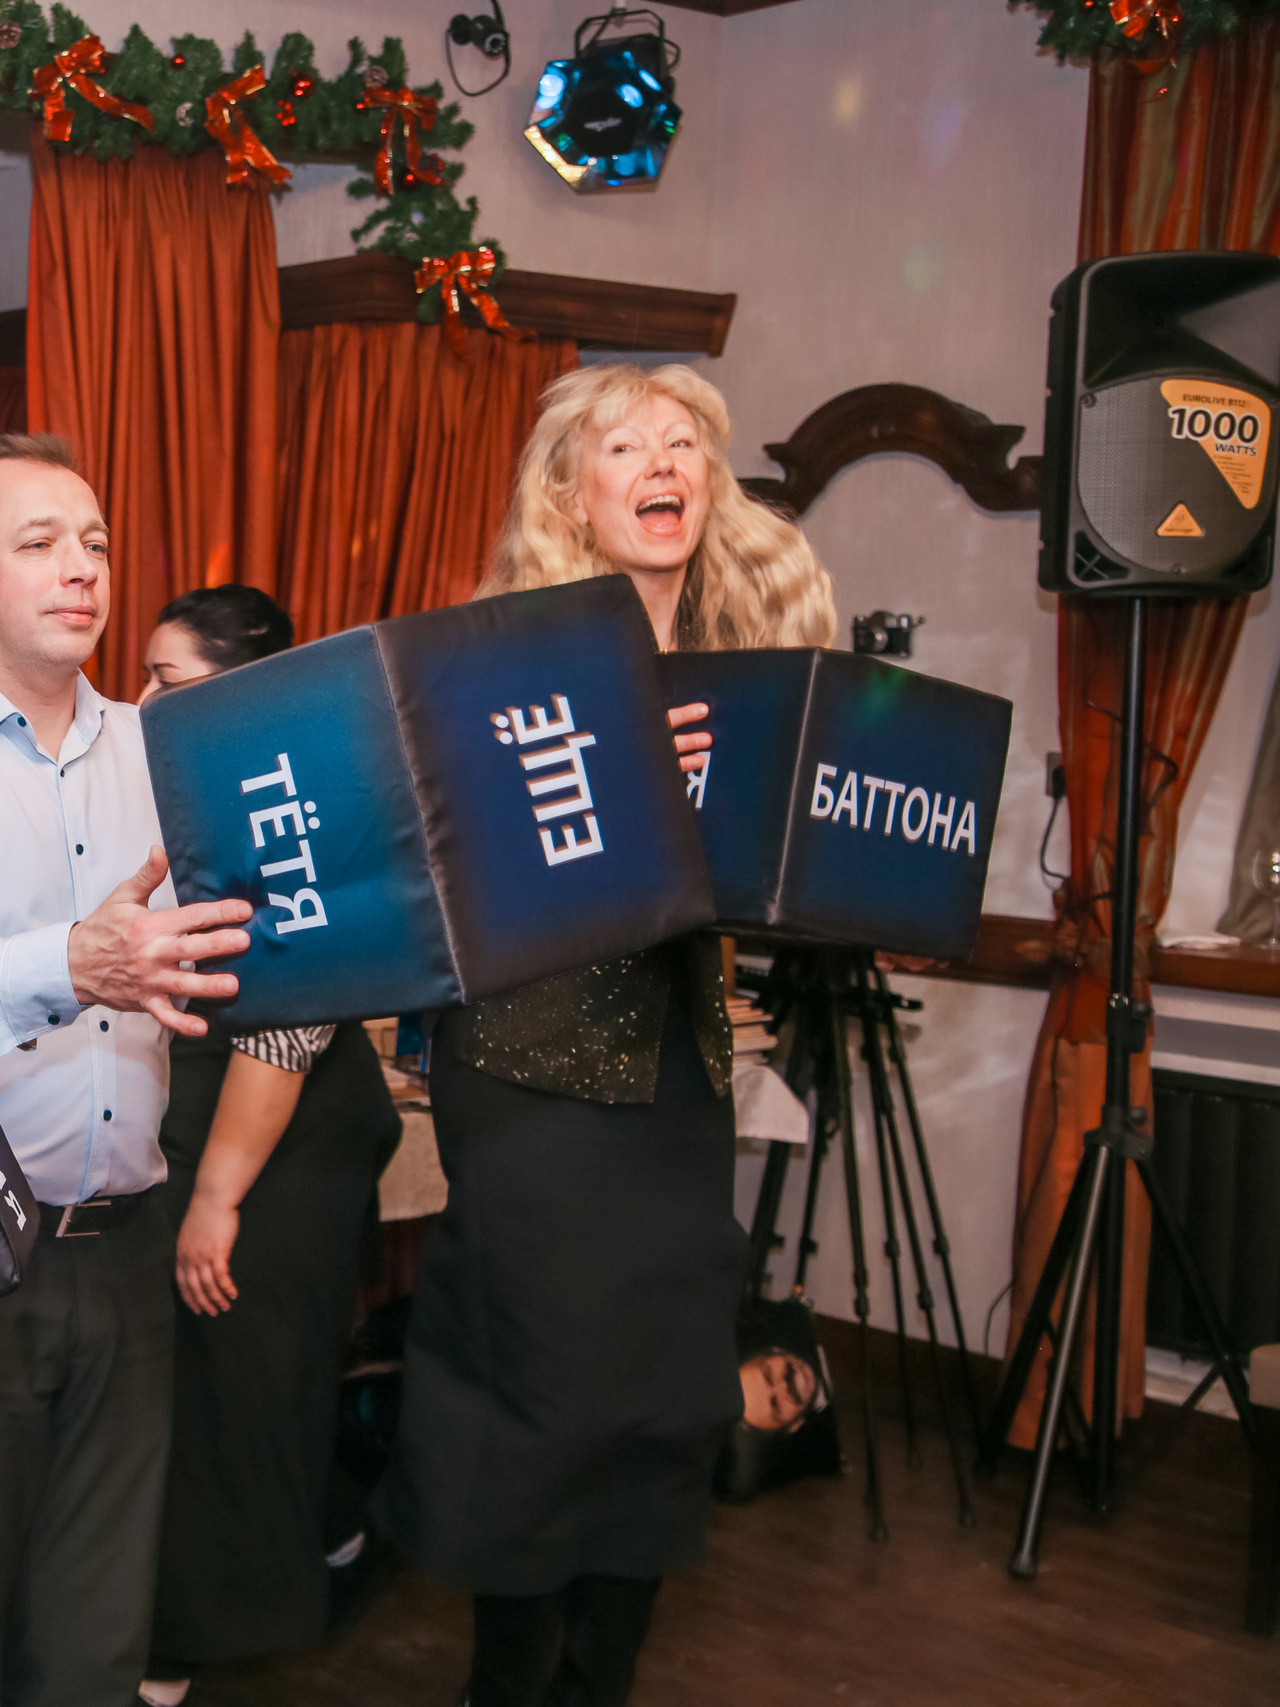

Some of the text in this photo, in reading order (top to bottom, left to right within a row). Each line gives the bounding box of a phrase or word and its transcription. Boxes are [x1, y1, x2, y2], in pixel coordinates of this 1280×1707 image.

[1170, 407, 1260, 444] 1000
[1182, 394, 1226, 406] EUROLIVE
[1214, 443, 1257, 457] WATTS
[490, 694, 605, 868] ЕЩЁ
[810, 762, 977, 856] БАТТОНА
[240, 752, 329, 935] ТЁТЯ
